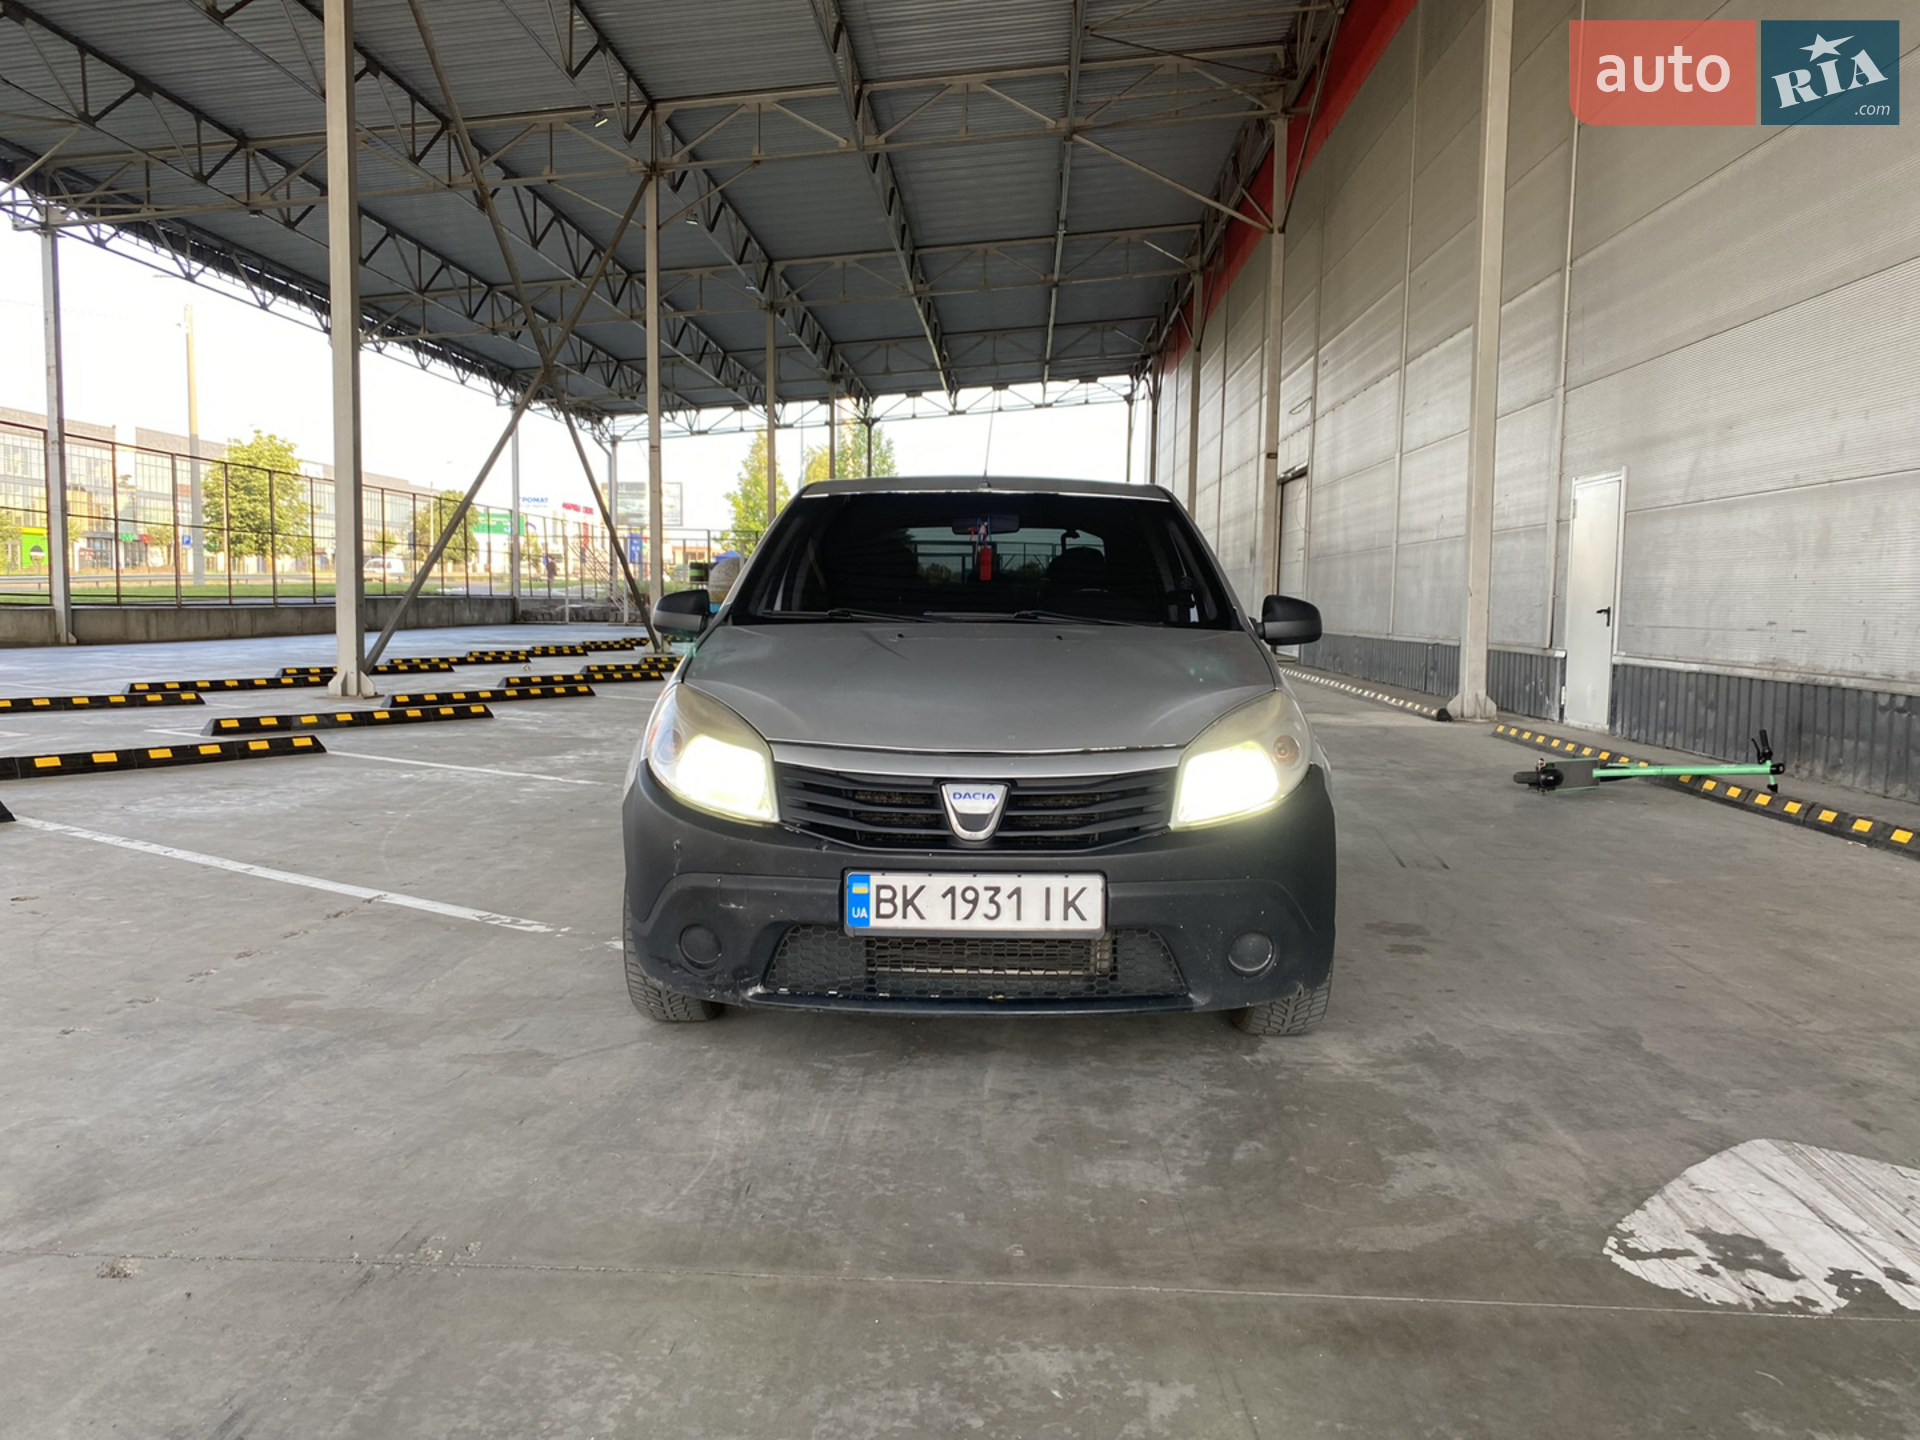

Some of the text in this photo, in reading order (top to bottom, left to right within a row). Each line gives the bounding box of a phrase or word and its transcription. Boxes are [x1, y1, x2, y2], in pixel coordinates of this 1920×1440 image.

[952, 792, 996, 800] DACIA
[875, 884, 1088, 921] BK 1931 IK
[851, 907, 868, 919] UA
